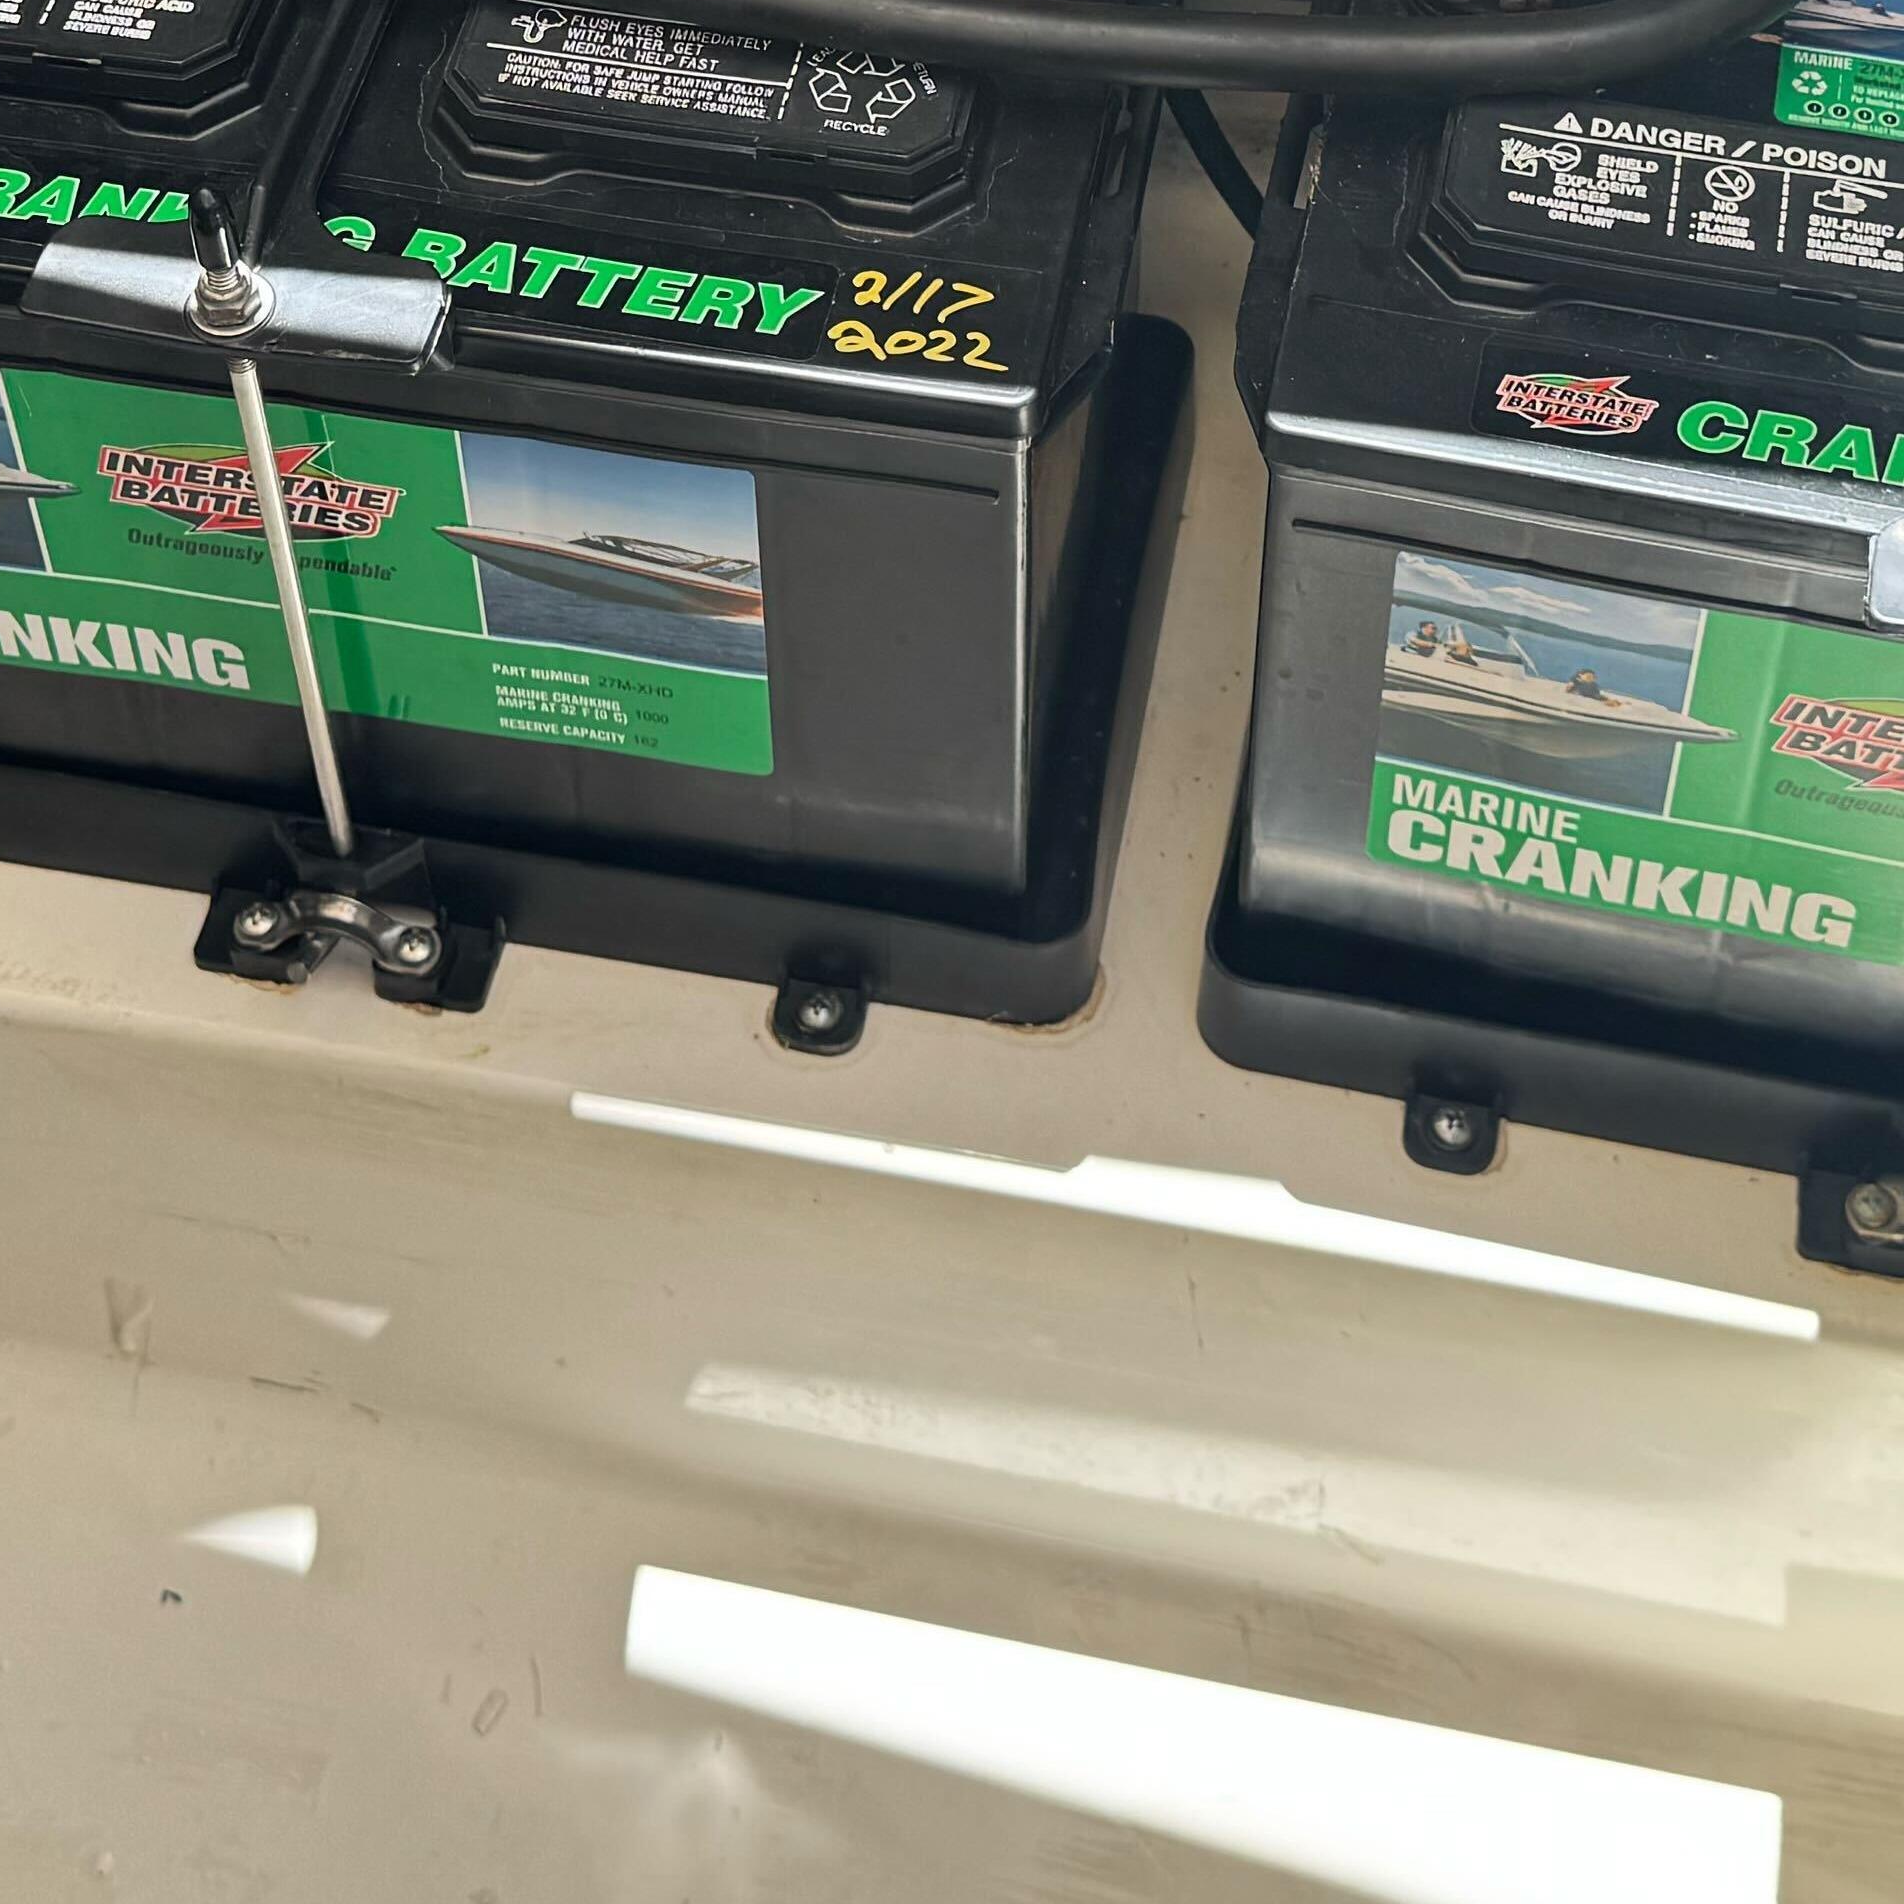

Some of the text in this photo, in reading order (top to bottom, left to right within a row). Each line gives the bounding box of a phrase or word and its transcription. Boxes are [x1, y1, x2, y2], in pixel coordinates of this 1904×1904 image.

[567, 27, 704, 56] WITH GET
[571, 14, 773, 52] FLUSH EYES IMMEDIATELY
[562, 39, 720, 72] MEDICAL HELP FAST
[1794, 51, 1853, 71] MARINE
[504, 62, 713, 102] INSTRUCTIONS VEHICLE OWNERS
[540, 78, 689, 109] AVAILABLE SERVICE
[626, 69, 775, 97] JUMP STARTING FOLLOW
[823, 118, 890, 136] RECYCLE
[1590, 117, 1888, 179] DANGER POISON
[1596, 167, 1641, 184] EYES
[1598, 154, 1659, 173] SHIELD
[1553, 185, 1610, 205] GASES
[1554, 173, 1648, 199] EXPLOSIVE
[1581, 202, 1651, 224] BLINDNESS
[1713, 200, 1738, 214] NO
[1808, 214, 1895, 239] SULFURIC
[401, 227, 824, 337] BATTERY
[851, 270, 994, 325] 2/17
[827, 323, 1009, 374] 2022
[1505, 377, 1646, 415] INTERSTATE
[1506, 395, 1635, 430] BATTERIES
[127, 527, 265, 565] Outrageously
[492, 662, 674, 699] PART NUMBER 27M-XHD
[496, 685, 621, 712] MARINE CRANKING
[497, 696, 669, 725] AMPS 1000
[499, 717, 626, 745] RESERVE CAPACITY
[1392, 773, 1581, 844] MARINE
[1387, 809, 1858, 948] CRANKING
